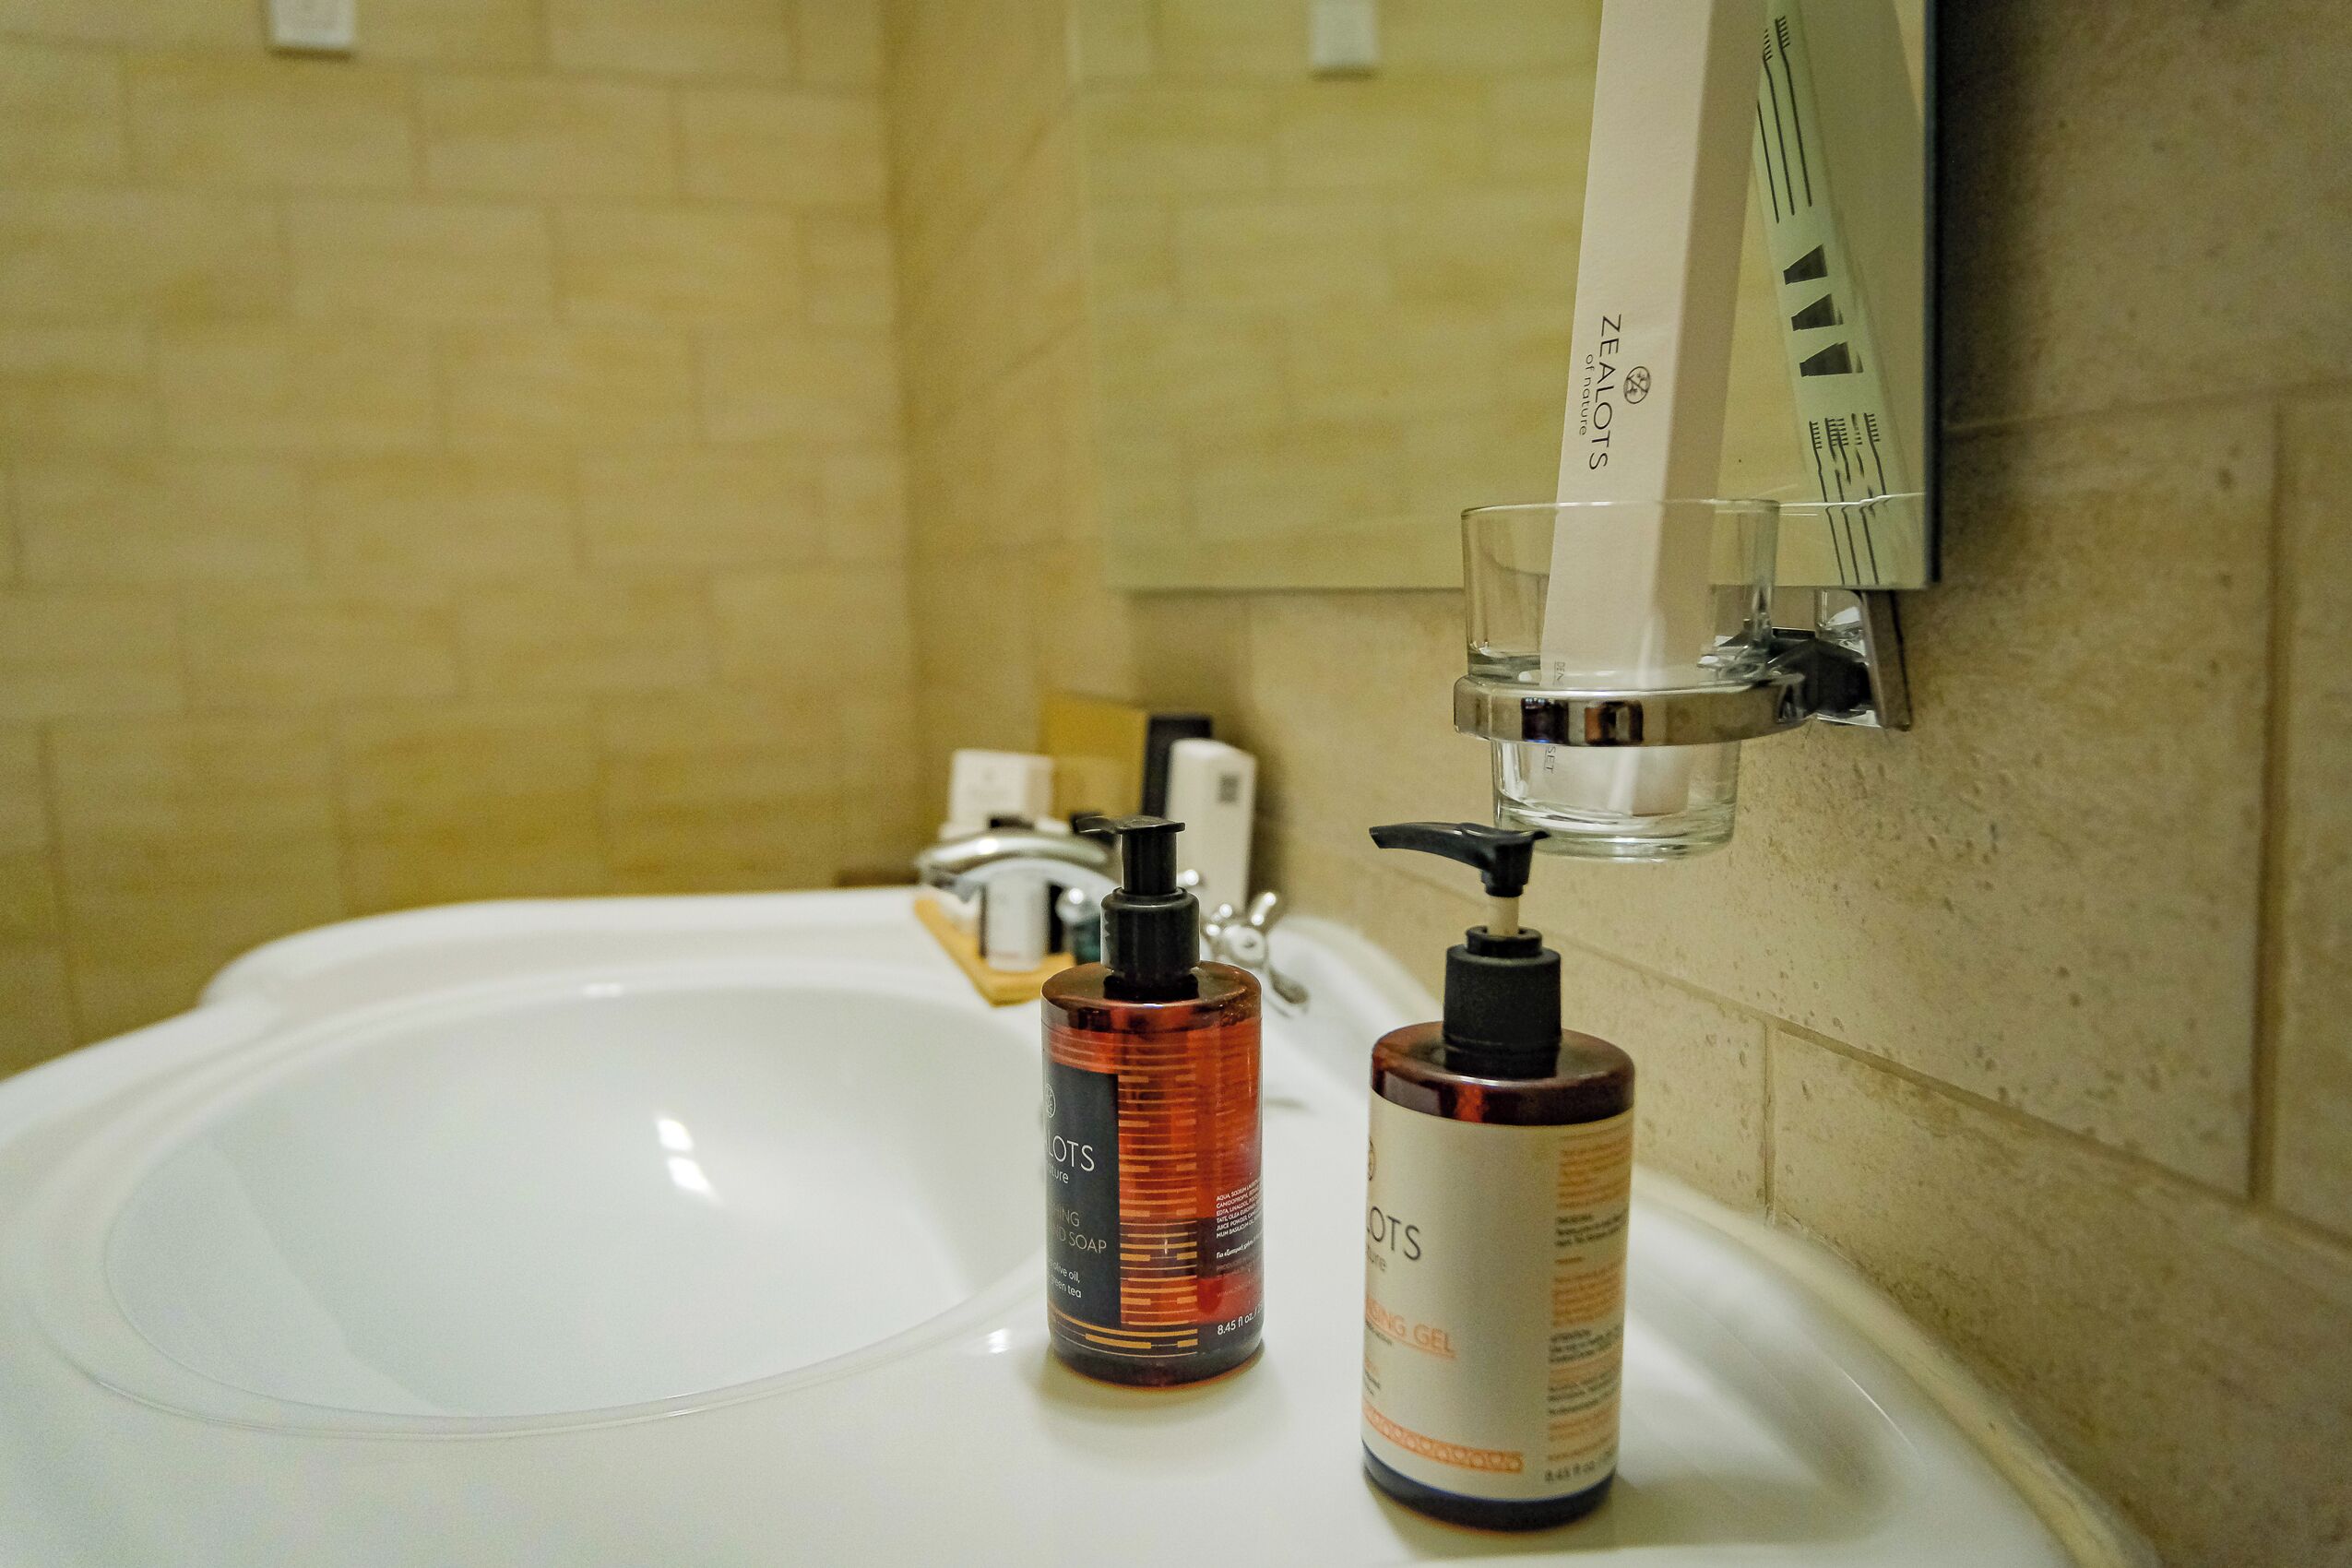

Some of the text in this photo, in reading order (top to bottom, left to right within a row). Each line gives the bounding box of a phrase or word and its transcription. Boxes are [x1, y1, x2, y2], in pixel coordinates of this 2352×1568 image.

[1579, 354, 1595, 435] of nature
[1589, 315, 1621, 470] ZEALOTS
[1047, 1130, 1095, 1171] LOTS
[1068, 1231, 1107, 1253] SOAP
[1368, 1206, 1421, 1261] OTS
[1068, 1271, 1080, 1283] oil,
[1068, 1285, 1082, 1298] tea
[1218, 1320, 1236, 1335] 8.45
[1238, 1315, 1243, 1327] fl
